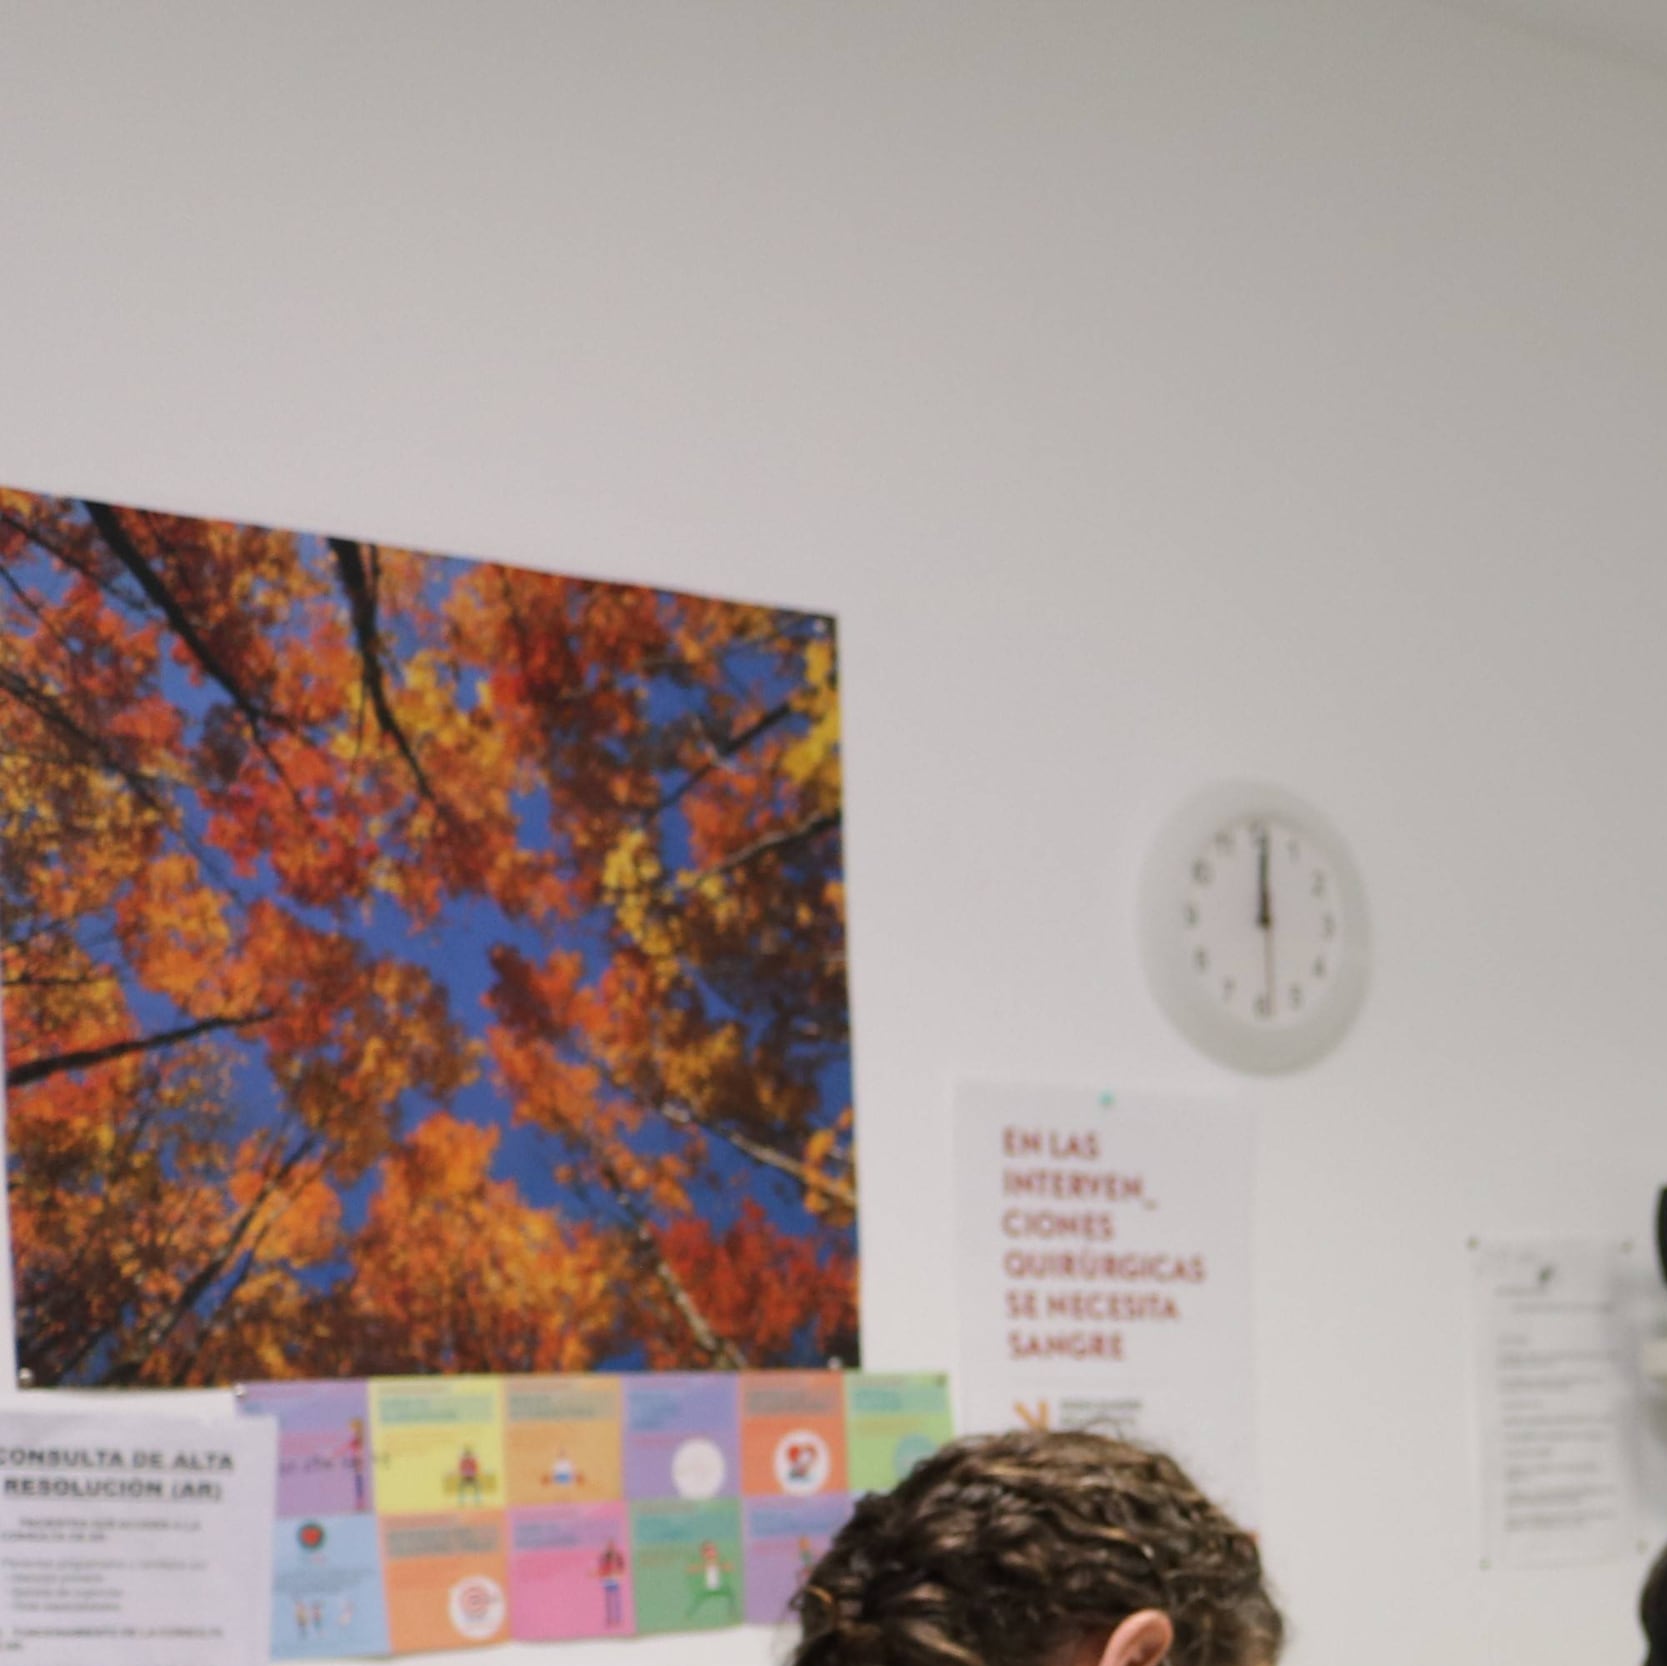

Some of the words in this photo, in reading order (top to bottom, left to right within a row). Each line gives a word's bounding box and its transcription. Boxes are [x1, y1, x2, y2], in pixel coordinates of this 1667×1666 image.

[1002, 1127, 1042, 1157] EN
[1048, 1130, 1100, 1160] LAS
[1002, 1211, 1113, 1240] CIONES
[1003, 1248, 1206, 1283] QUIRÚRGICAS
[1006, 1290, 1038, 1319] SE
[1046, 1291, 1179, 1322] NECESITA
[1008, 1331, 1123, 1361] SANGRE
[131, 1450, 164, 1470] DE
[171, 1451, 234, 1472] ALTA
[3, 1477, 163, 1499] RESOLUCIÓN
[171, 1481, 221, 1501] (AR)
